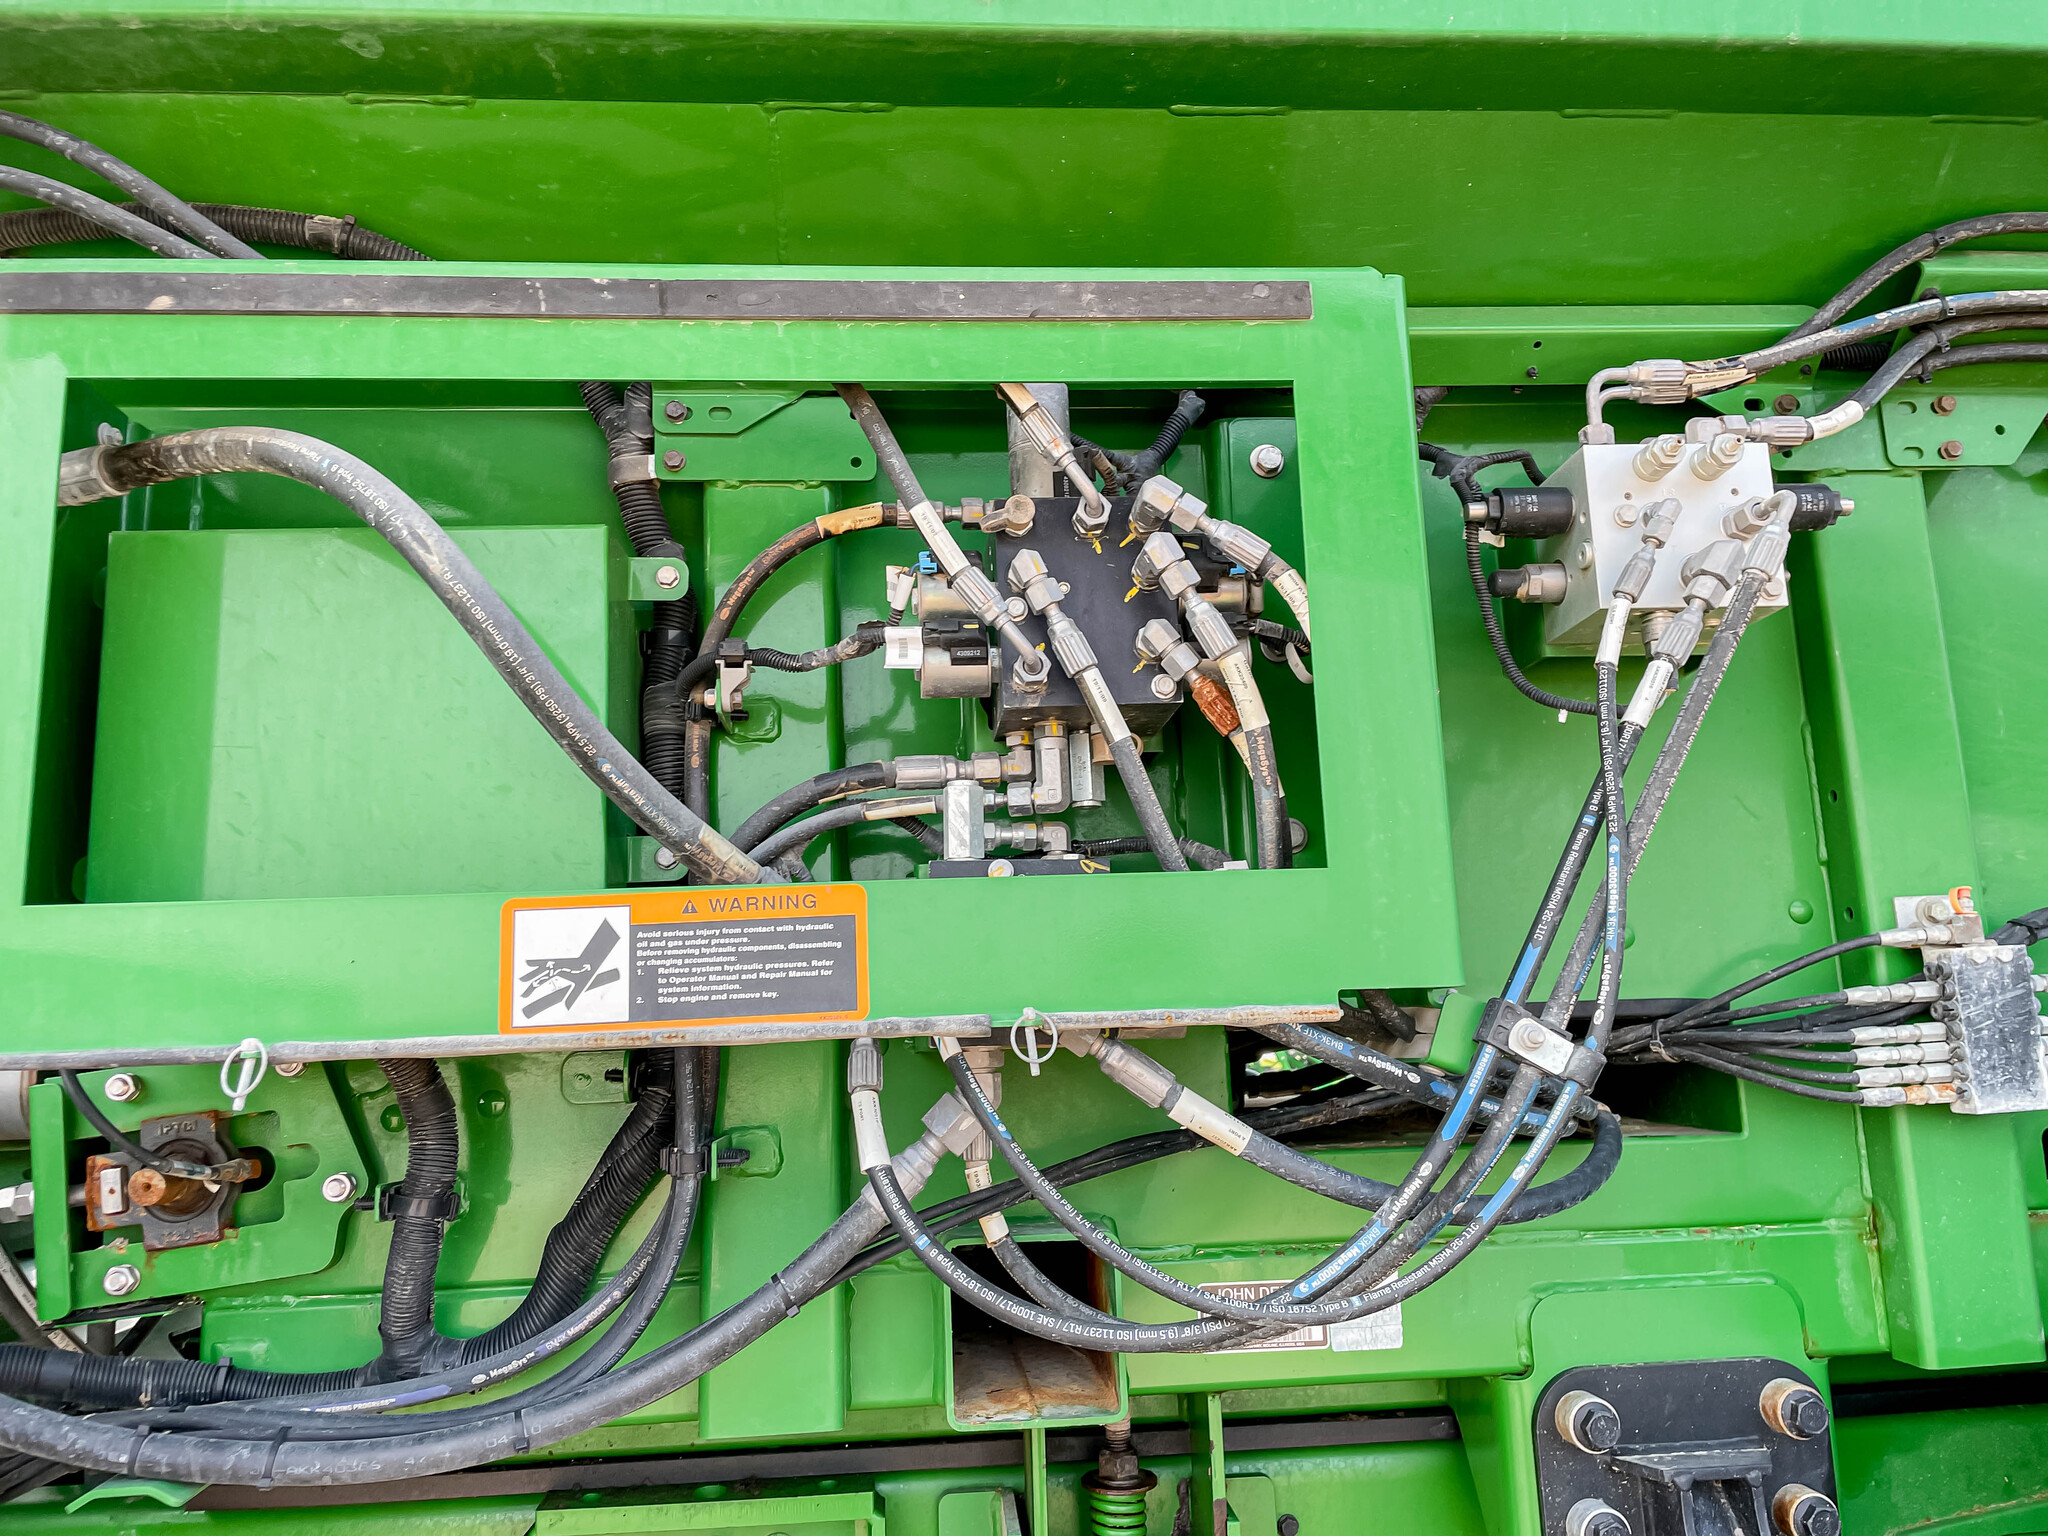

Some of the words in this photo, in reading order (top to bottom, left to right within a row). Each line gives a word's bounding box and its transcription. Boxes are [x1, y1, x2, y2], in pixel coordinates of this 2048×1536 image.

[352, 478, 376, 502] 18752
[374, 498, 389, 513] ISO
[449, 580, 476, 607] 11237
[471, 606, 488, 623] ISO
[481, 620, 503, 642] mm)
[499, 641, 524, 667] (19.0
[530, 680, 551, 700] PSI)
[545, 698, 570, 724] (3250
[1600, 701, 1610, 720] mm)
[566, 721, 581, 742] MPa
[1600, 720, 1611, 737] (6.3
[579, 737, 597, 756] 22.5
[1603, 752, 1614, 768] PSI)
[1605, 769, 1618, 794] (3250
[1608, 795, 1617, 813] MPa
[1608, 814, 1618, 833] 22.5
[1571, 827, 1588, 850] Flame
[1557, 850, 1579, 887] Resistant
[1607, 857, 1618, 914] Mega3000™
[708, 893, 817, 912] WARNING
[1546, 885, 1564, 909] MSHA
[663, 929, 694, 937] serious
[696, 928, 720, 936] injury
[743, 925, 774, 933] contact
[776, 924, 794, 932] with
[796, 923, 834, 932] hydraulic
[1533, 909, 1554, 941] 2G-11C
[1607, 915, 1616, 940] 4M3K
[664, 948, 700, 956] removing
[701, 946, 736, 955] hydraulic
[738, 943, 787, 952] components,
[788, 941, 842, 950] disassembling
[667, 939, 683, 948] gas
[685, 938, 709, 946] under
[711, 937, 750, 946] pressure.
[647, 958, 683, 966] changing
[684, 956, 738, 964] accumulators:
[658, 967, 690, 975] Relieve
[691, 966, 722, 974] system
[724, 963, 763, 972] hydraulic
[765, 961, 810, 970] pressures.
[669, 975, 707, 984] Operator
[759, 971, 787, 979] Repair
[1597, 954, 1612, 1005] MegaSys™
[658, 986, 689, 995] system
[690, 983, 742, 992] information.
[658, 996, 678, 1004] Stop
[680, 994, 709, 1003] engine
[729, 992, 760, 1000] remove
[762, 991, 779, 999] key.
[1301, 1027, 1344, 1051] 8M3K-XTF
[1358, 1054, 1403, 1078] MegaSys™
[1469, 1051, 1492, 1095] PROGRESS™
[965, 1070, 1000, 1122] Mega3000™
[1525, 1125, 1551, 1162] POWERING
[1546, 1085, 1572, 1128] PROGRESS™
[878, 1171, 901, 1211] Resistant
[1387, 1177, 1423, 1221] MegaSys™
[897, 1209, 919, 1236] Flame
[1010, 1142, 1026, 1160] 22.5
[1024, 1159, 1040, 1177] MPa
[1037, 1176, 1062, 1201] (3250
[1059, 1199, 1077, 1217] PSI)
[1110, 1242, 1132, 1262] mm)
[1176, 1281, 1197, 1293] R17
[1203, 1291, 1221, 1303] SAE
[1223, 1297, 1261, 1312] 100R17
[1269, 1304, 1285, 1314] ISO
[1287, 1303, 1317, 1314] 18752
[1319, 1302, 1342, 1314] Type
[1342, 1300, 1349, 1308] B
[1363, 1285, 1392, 1303] Flame
[1390, 1264, 1432, 1290] Resistant
[1430, 1247, 1453, 1268] MSHA
[1450, 1222, 1480, 1250] 2G-11C
[1361, 1226, 1381, 1250] 6M3K
[929, 1248, 938, 1258] B
[937, 1253, 955, 1274] Type
[1311, 1245, 1361, 1288] Mega3000™
[953, 1268, 981, 1293] 18752
[981, 1289, 997, 1303] ISO
[1218, 1286, 1255, 1300] JOHN
[1000, 1299, 1035, 1320] 100R17
[489, 1351, 535, 1379] MegaSys™
[623, 1269, 641, 1288] 28.0
[1036, 1313, 1055, 1328] SAE
[1062, 1321, 1083, 1335] R17
[1083, 1322, 1114, 1338] 11237
[1201, 1319, 1223, 1334] PSI)
[1116, 1330, 1133, 1341] ISO
[1135, 1328, 1158, 1341] mm)
[1159, 1326, 1179, 1340] (9.5
[1181, 1324, 1201, 1338] 3/8"
